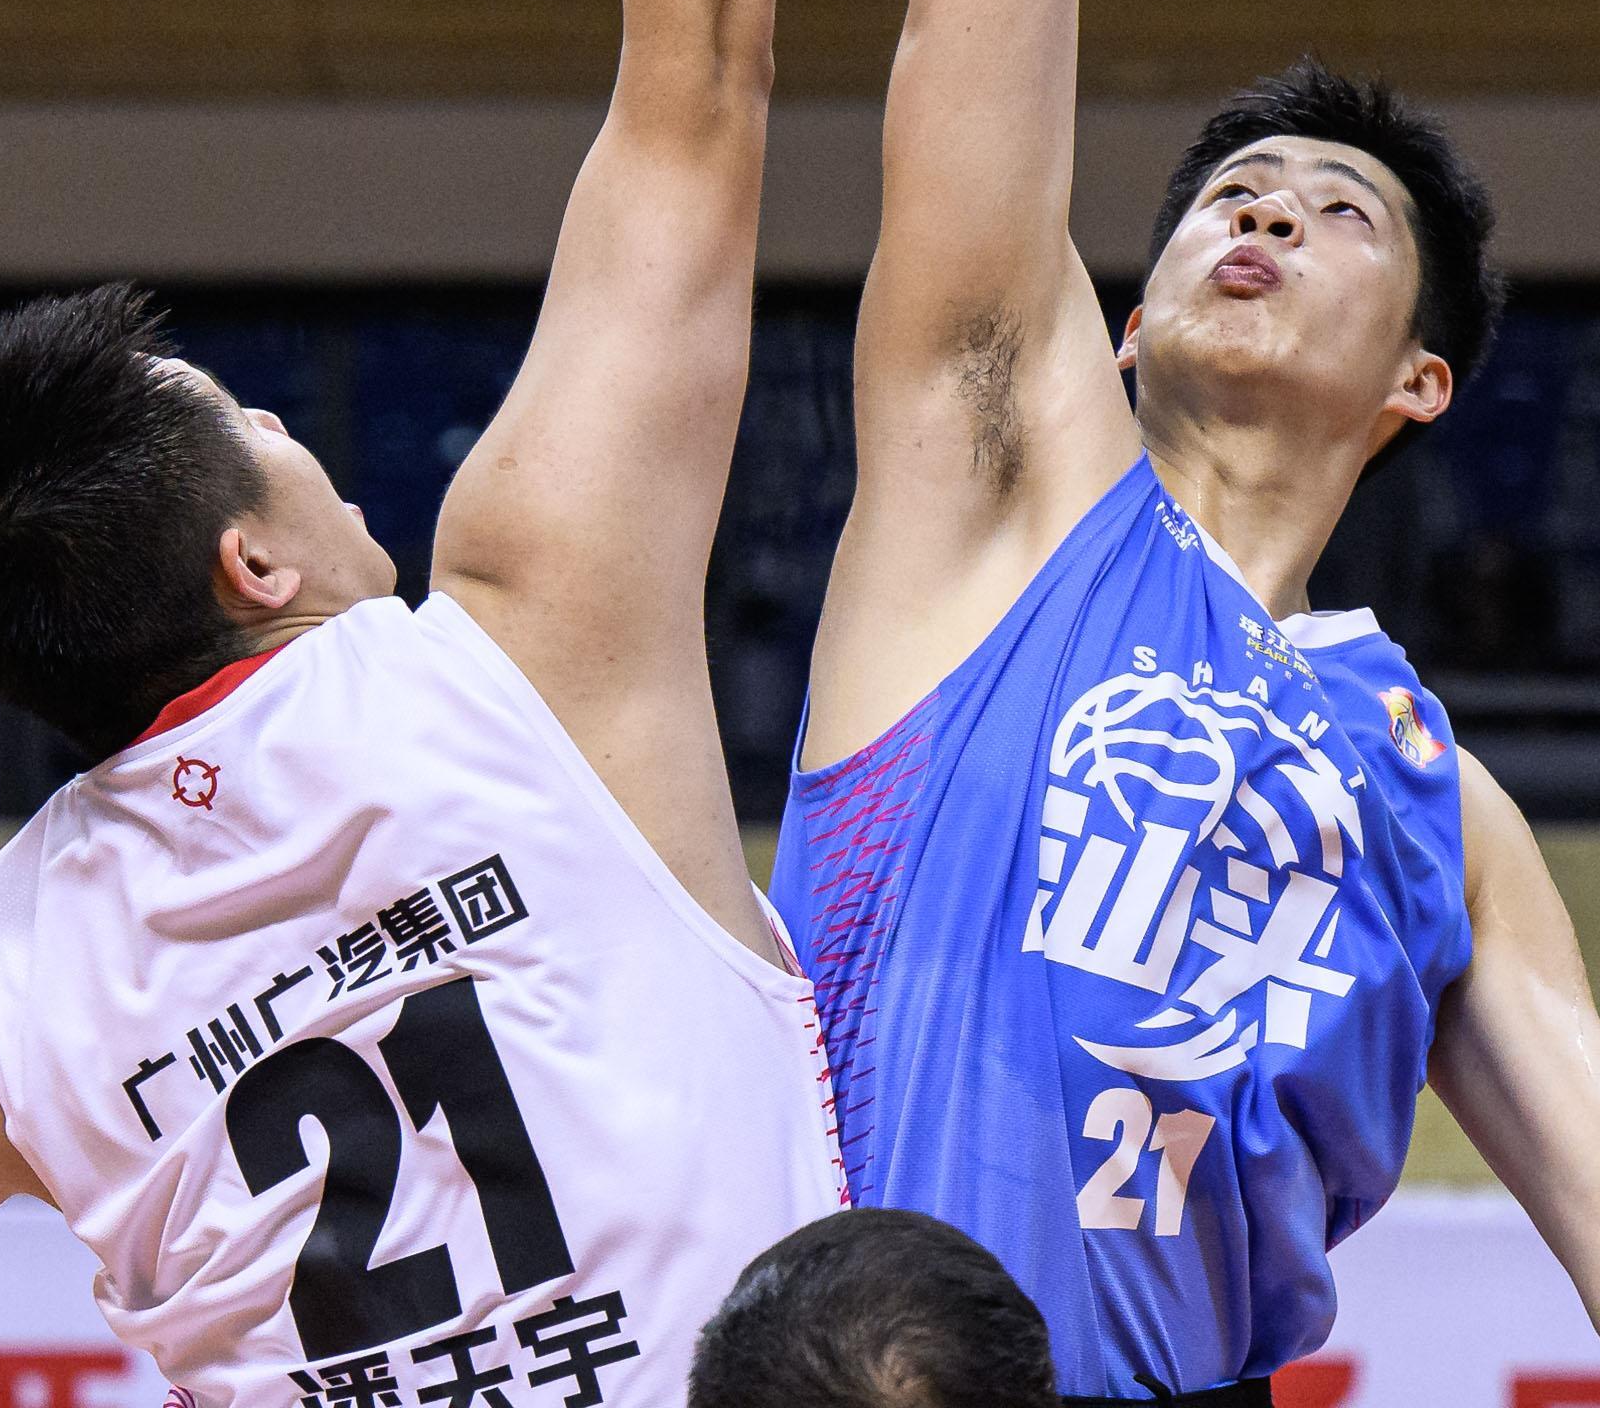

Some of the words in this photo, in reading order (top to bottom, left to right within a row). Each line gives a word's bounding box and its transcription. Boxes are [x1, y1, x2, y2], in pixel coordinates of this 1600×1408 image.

[122, 853, 530, 1142] 广州广汽集团
[225, 975, 576, 1362] 21
[1077, 1088, 1216, 1236] 21
